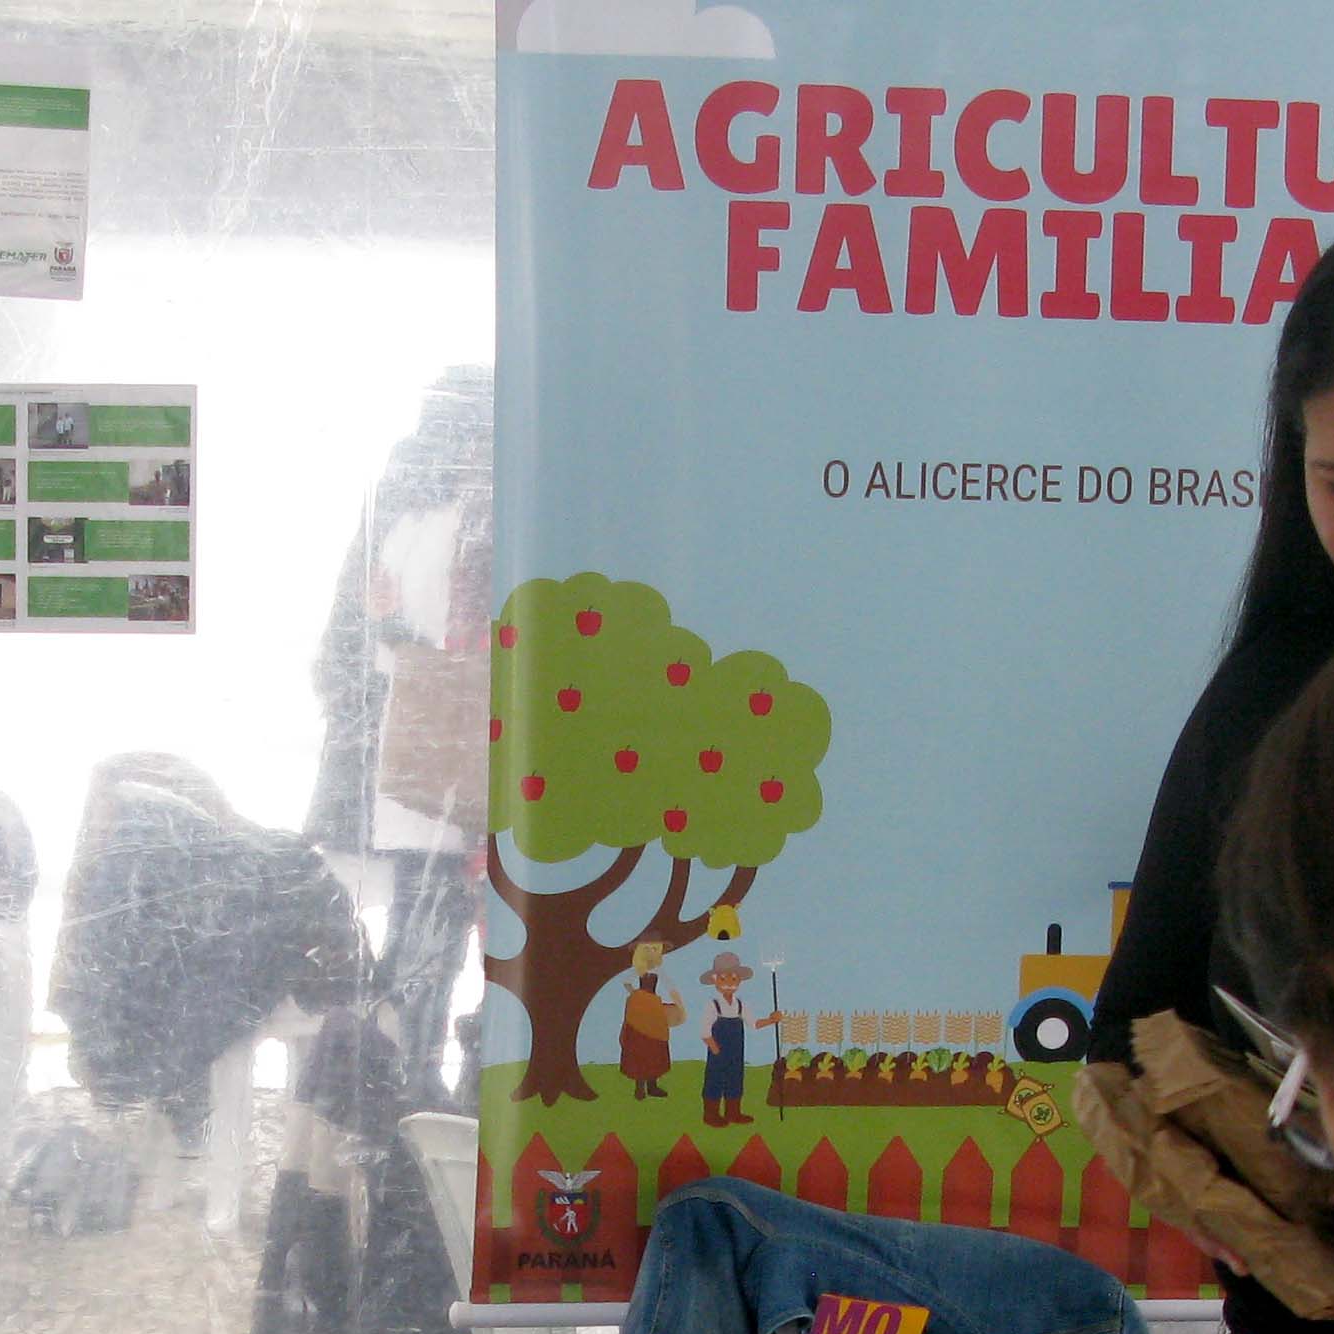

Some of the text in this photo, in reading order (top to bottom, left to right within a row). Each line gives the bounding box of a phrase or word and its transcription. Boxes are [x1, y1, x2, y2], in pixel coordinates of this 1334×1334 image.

[822, 459, 850, 499] O
[864, 461, 1063, 503] ALICERCE
[1078, 466, 1133, 505] DO
[518, 1247, 617, 1270] PARANÁ
